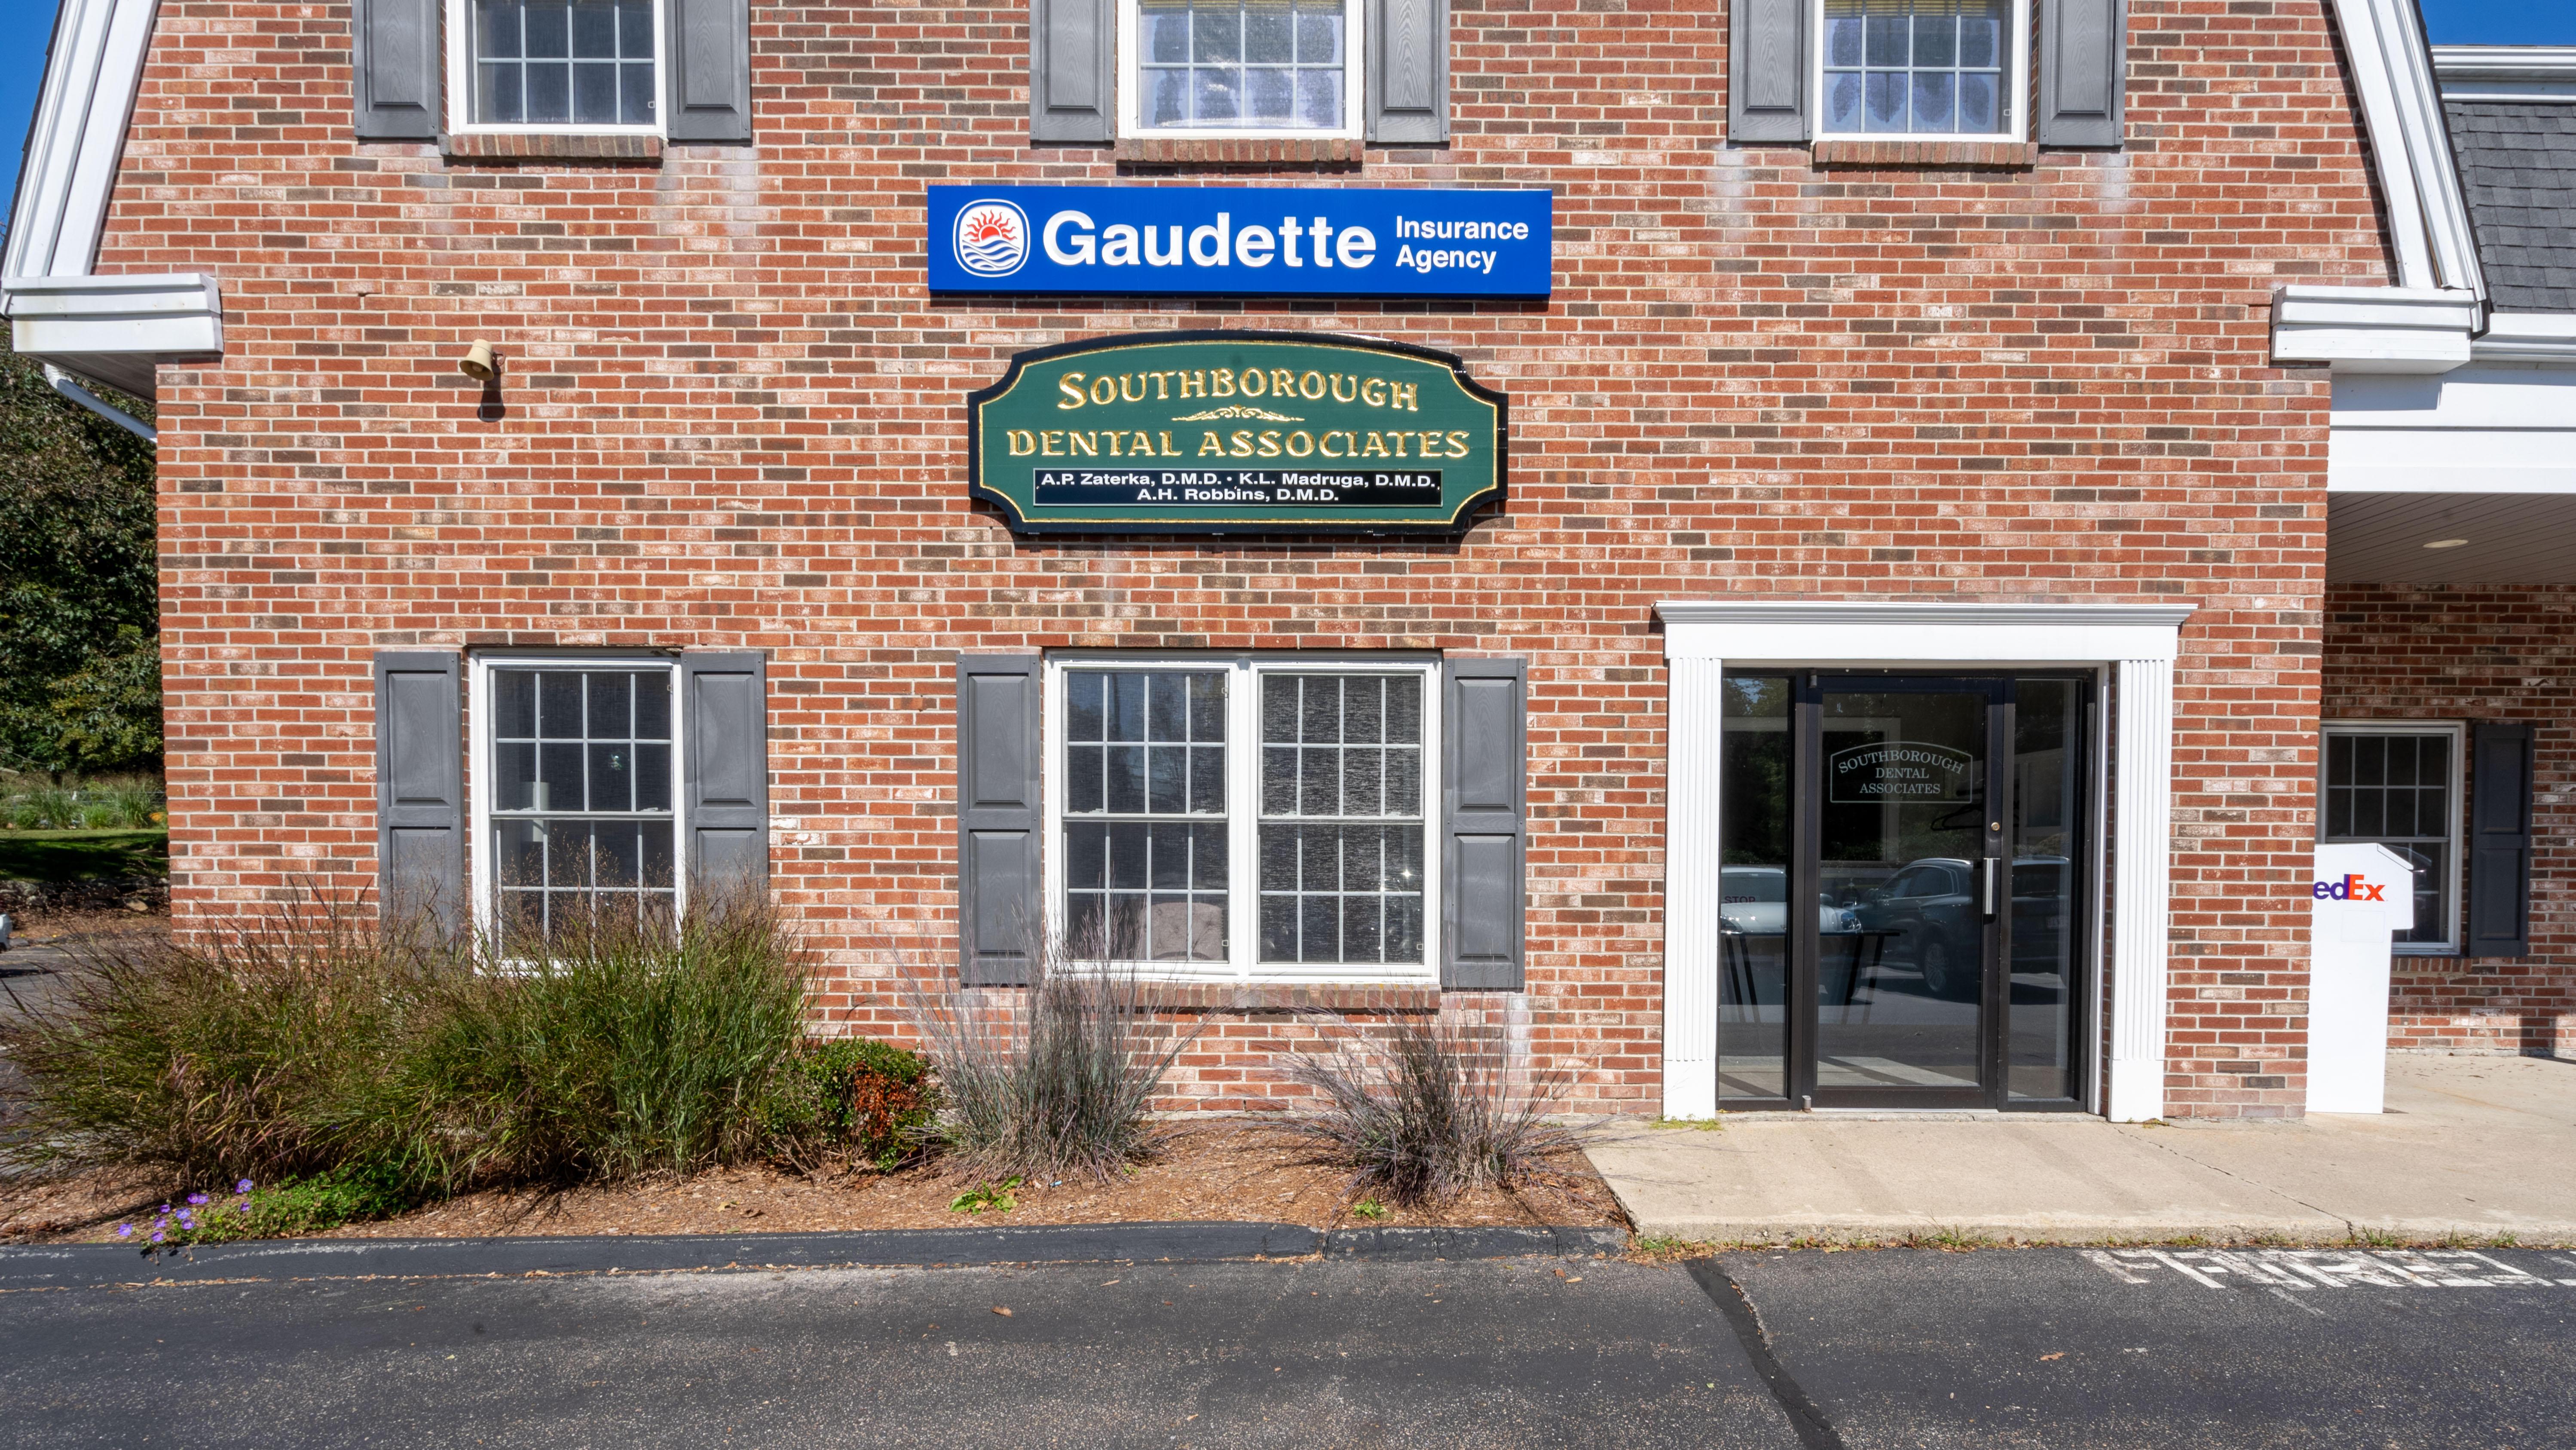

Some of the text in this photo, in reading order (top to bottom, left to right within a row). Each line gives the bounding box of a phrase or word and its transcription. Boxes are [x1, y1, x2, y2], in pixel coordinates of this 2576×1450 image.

[1043, 210, 1376, 268] Gaudette
[1396, 215, 1529, 240] Insurance
[1395, 245, 1496, 274] Agency
[1058, 368, 1419, 412] SOUTHBOROUGH
[1007, 430, 1469, 458] DENTAL ASSOCIATES
[1041, 473, 1435, 488] A.P. Zaterka, D.M.D. K.L. Madruga, D.M.D.
[1137, 488, 1339, 502] A.H. Robbins, D.M.D.
[1839, 750, 1964, 774] SOUTHBOROUGH
[1875, 768, 1929, 779] DENTAL
[1859, 783, 1941, 794] ASSOCIATES
[2313, 874, 2386, 901] edEx
